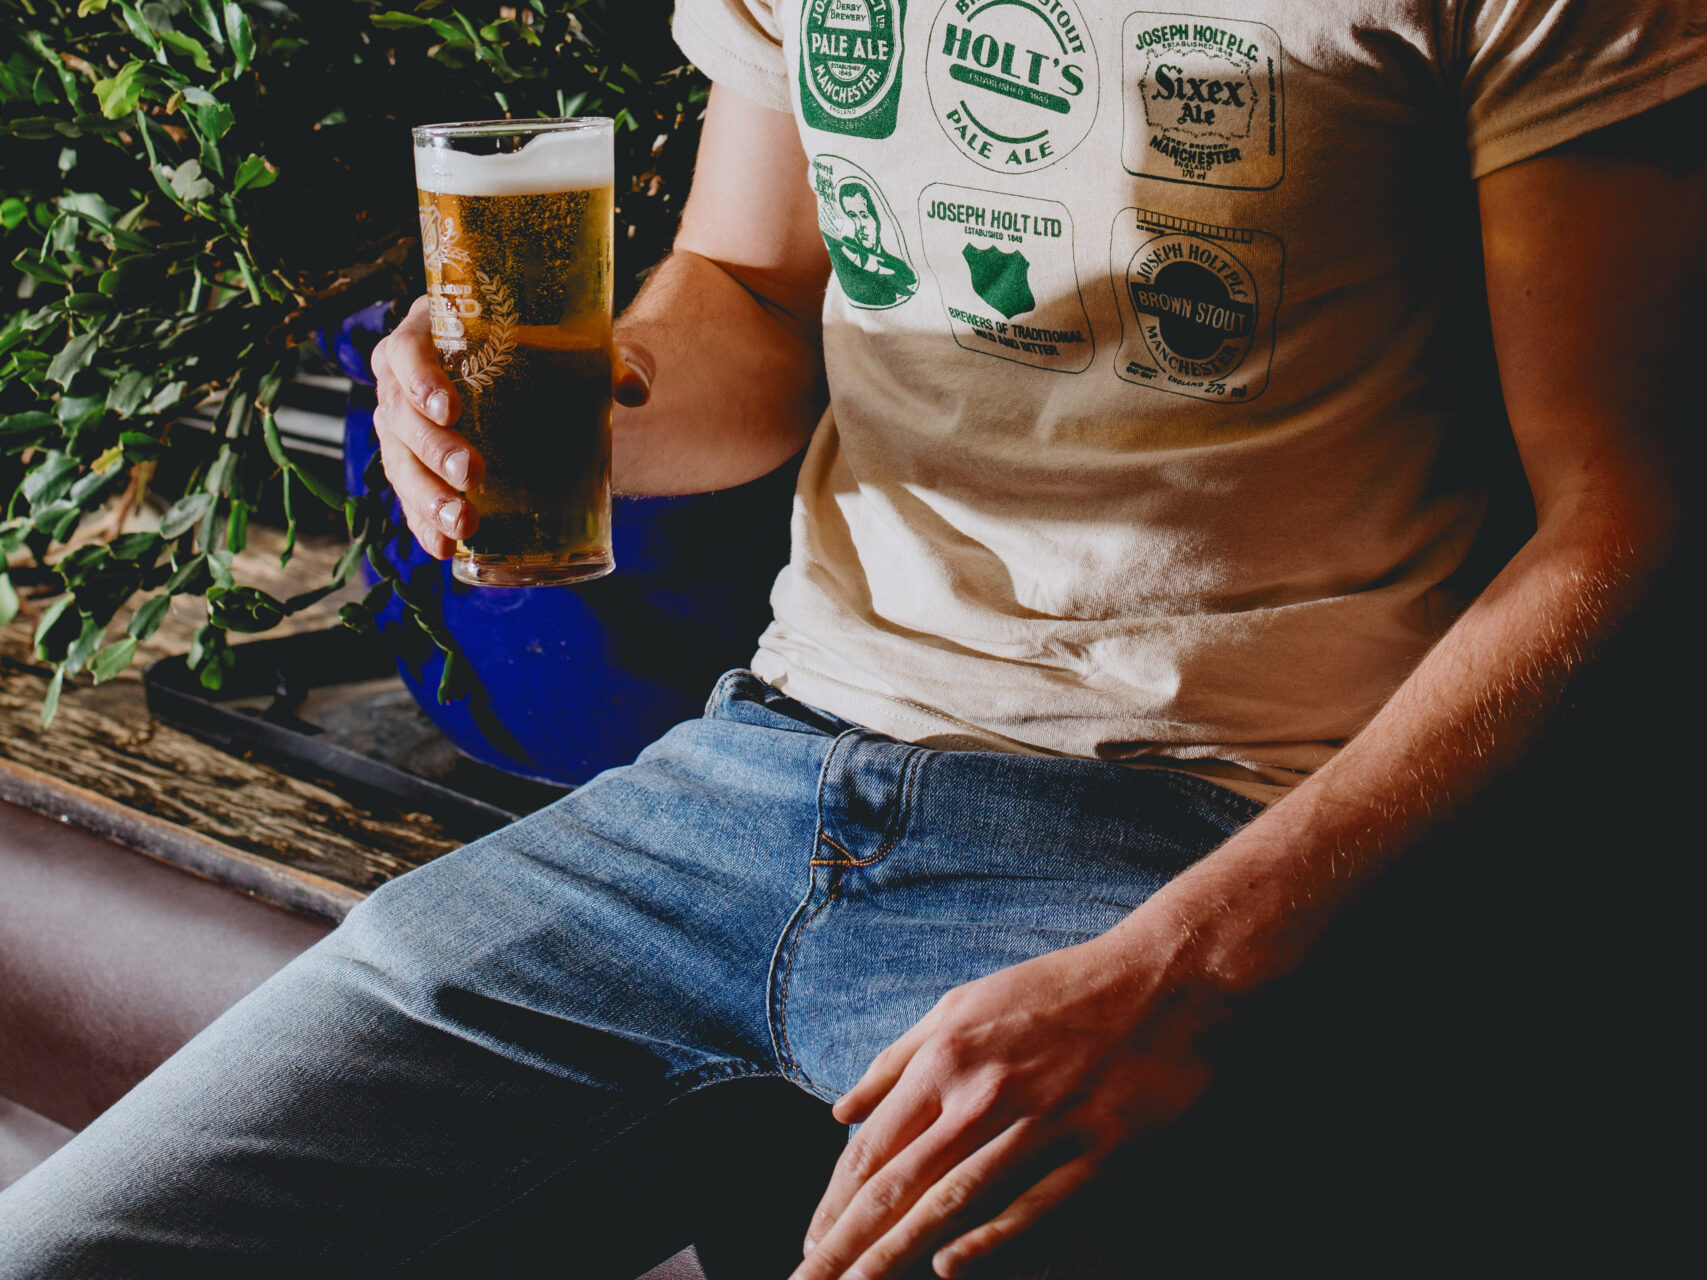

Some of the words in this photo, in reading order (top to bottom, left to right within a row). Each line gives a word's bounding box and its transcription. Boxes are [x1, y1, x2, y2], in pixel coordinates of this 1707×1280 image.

[830, 8, 867, 22] BREWERY
[835, 0, 862, 12] DERBY
[811, 32, 848, 57] PALE
[853, 37, 889, 61] ALE
[1135, 23, 1189, 51] JOSEPH
[1192, 24, 1228, 46] HOLT
[1161, 41, 1214, 51] ESTABLISHED
[942, 22, 1084, 97] HOLT'S
[968, 71, 1024, 97] ESTABLISHED
[1151, 63, 1246, 108] Sixex
[829, 104, 857, 116] ENGLAND
[1177, 102, 1216, 126] Ale
[945, 108, 994, 160] PALE
[1005, 140, 1054, 166] ALE
[1149, 134, 1243, 166] MANCHESTER
[1161, 133, 1187, 147] DERBY
[1188, 142, 1229, 151] BREWERY
[1173, 160, 1212, 171] ENGLAND
[927, 200, 986, 227] JOSEPH
[990, 209, 1032, 234] HOLT
[1033, 216, 1063, 239] LTD
[964, 225, 1004, 241] ESTABLISHED
[1136, 242, 1184, 283] JOSEPH
[1188, 243, 1229, 276] HOLT
[948, 306, 994, 331] BREWERS
[995, 321, 1009, 335] OF
[1011, 324, 1087, 344] TRADITIONAL
[1137, 290, 1192, 319] BROWN
[1195, 302, 1248, 333] STOUT
[1019, 341, 1061, 356] BITTER
[1146, 324, 1241, 378] MANCHESTER
[1167, 375, 1205, 388] ENGLAND
